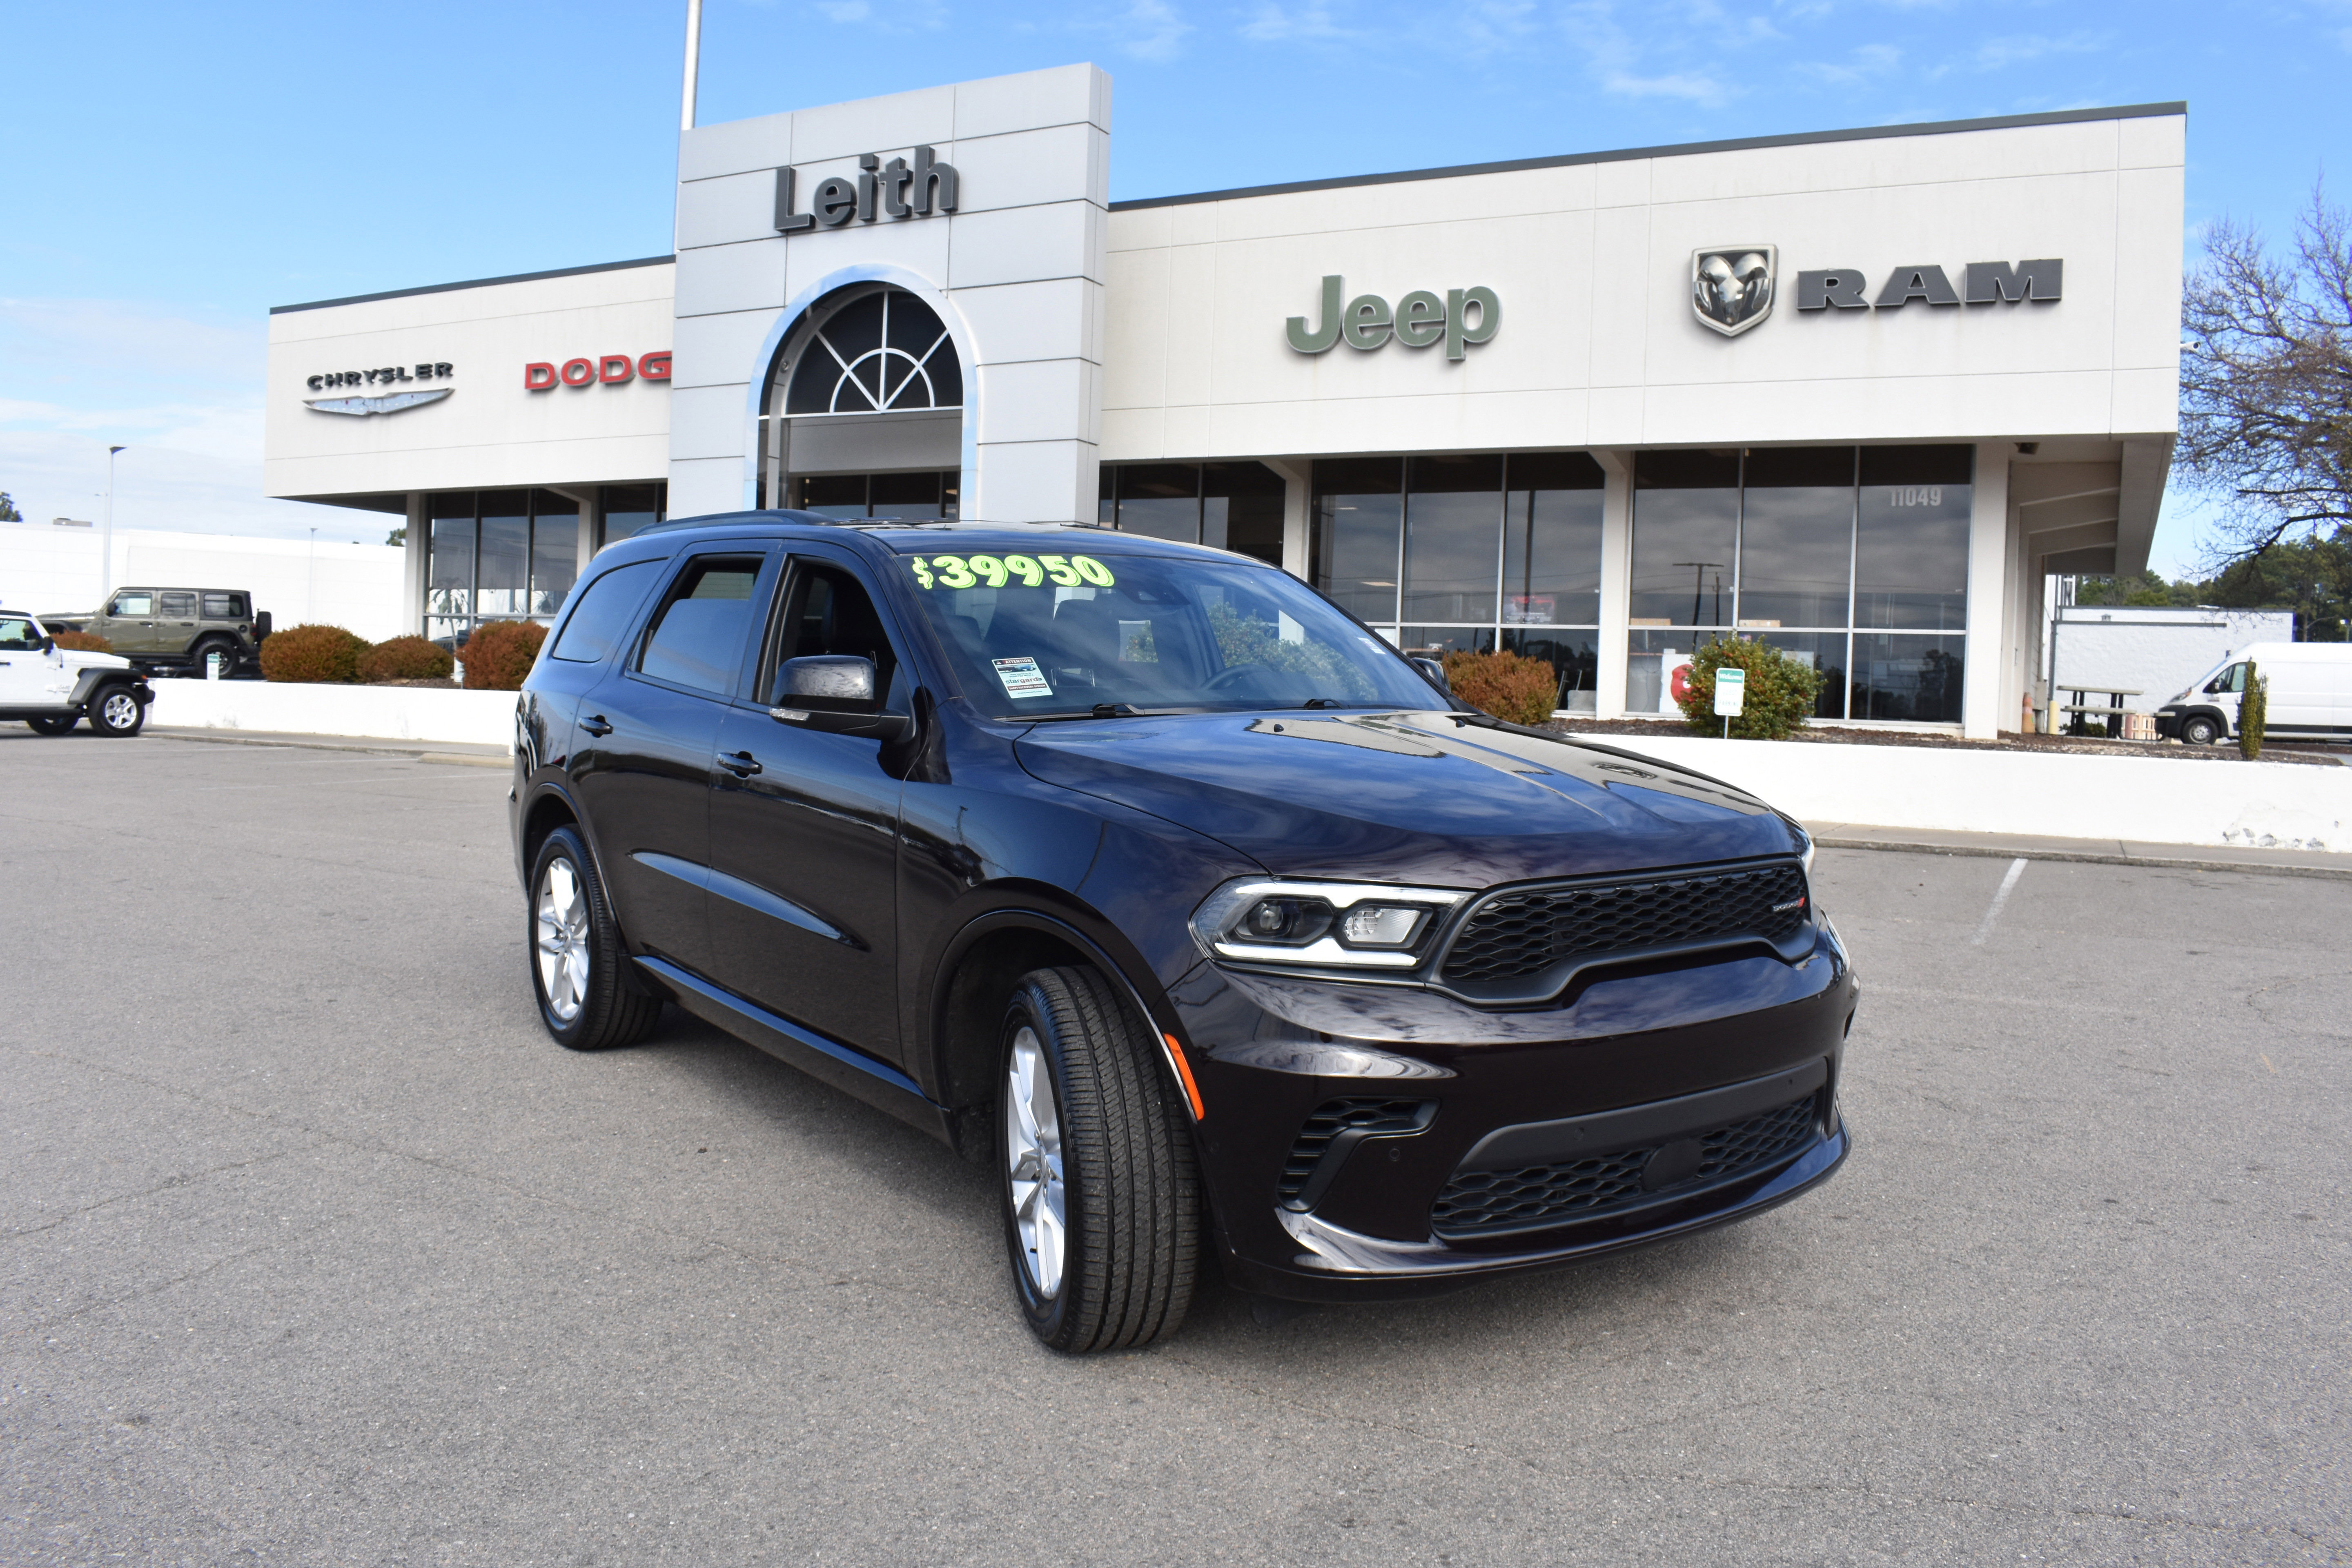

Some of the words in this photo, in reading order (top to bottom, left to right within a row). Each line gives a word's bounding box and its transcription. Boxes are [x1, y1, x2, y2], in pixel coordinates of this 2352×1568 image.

[775, 145, 960, 232] Leith
[1797, 258, 2064, 311] RAM
[1286, 274, 1503, 361] Jeep
[307, 362, 453, 389] CHRYSLER
[525, 350, 672, 390] DODG
[1891, 486, 1942, 506] 11049
[912, 555, 1114, 589] $39950
[1773, 900, 1799, 911] DODGE
